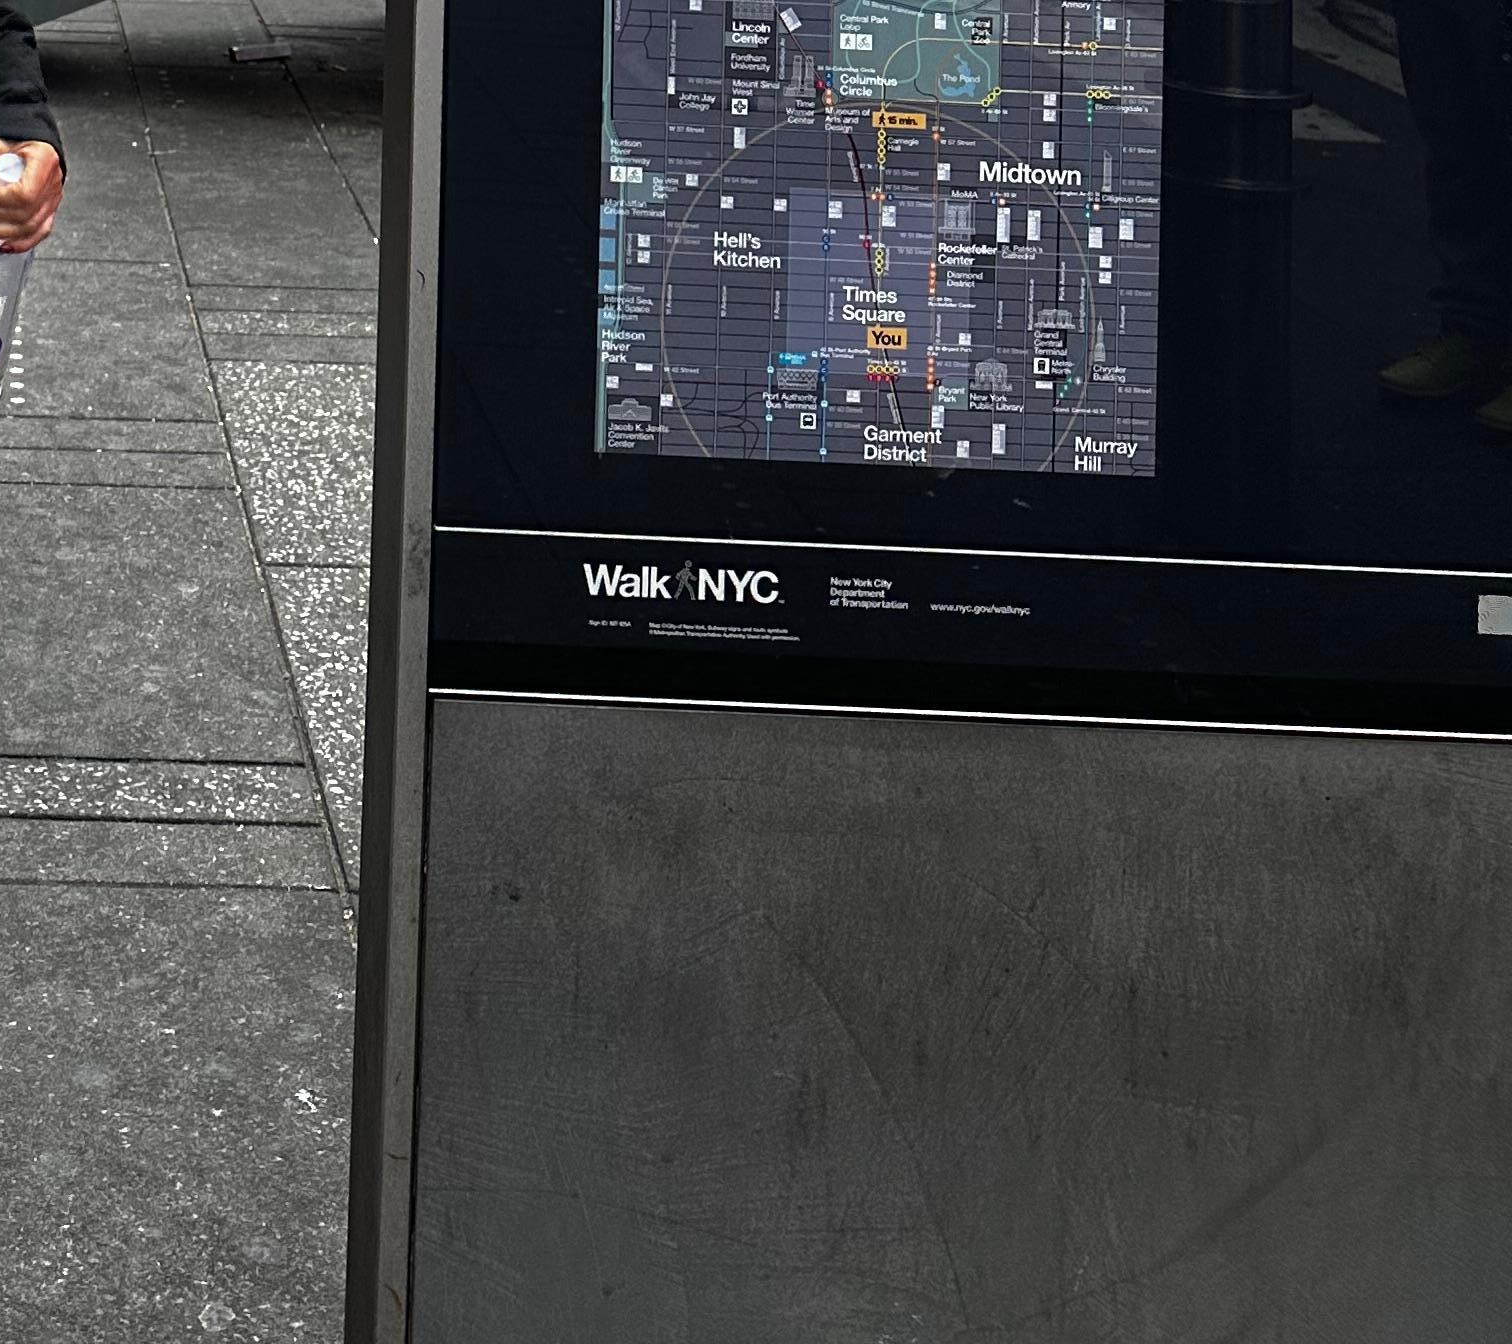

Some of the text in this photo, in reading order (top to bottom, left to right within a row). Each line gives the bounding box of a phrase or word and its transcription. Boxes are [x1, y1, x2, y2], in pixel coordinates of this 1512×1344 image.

[732, 22, 771, 33] Lincoln
[732, 33, 769, 45] Center
[840, 74, 898, 87] Columbus
[840, 86, 872, 97] Circle
[979, 161, 1082, 186] Midtown
[713, 231, 761, 250] Hell's
[938, 243, 998, 255] Rockefeller
[713, 250, 781, 269] Kitchen
[938, 255, 975, 265] Center
[842, 285, 898, 304] Times
[842, 305, 906, 324] Square
[601, 329, 645, 341] Hudson
[871, 331, 902, 346] You
[601, 340, 631, 352] River
[601, 352, 627, 363] Park
[863, 424, 942, 445] Garment
[863, 444, 928, 463] District
[1074, 437, 1138, 458] Murray
[1074, 456, 1102, 472] Hill
[582, 562, 779, 604] Walk NYC
[830, 576, 849, 587] New
[850, 577, 872, 588] York
[830, 587, 886, 600] Department
[841, 597, 909, 610] Transportation
